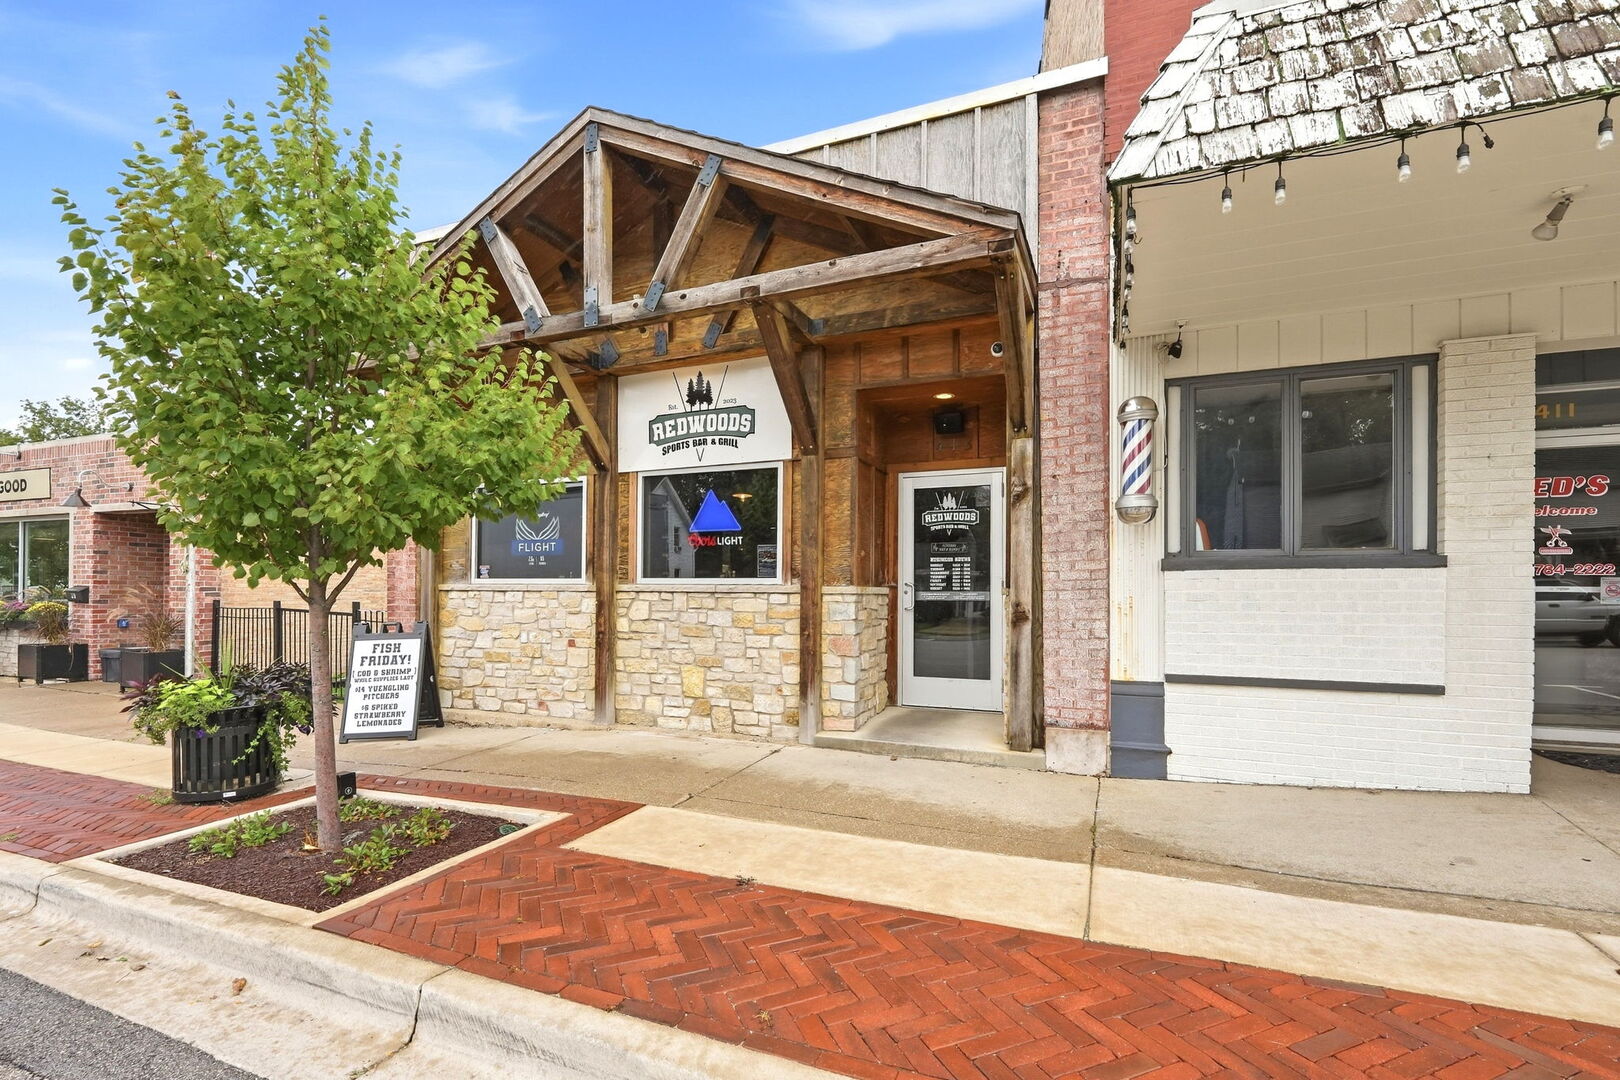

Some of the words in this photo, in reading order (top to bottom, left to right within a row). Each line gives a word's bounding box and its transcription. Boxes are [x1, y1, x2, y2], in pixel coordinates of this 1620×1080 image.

[1535, 402, 1576, 419] 411
[652, 413, 752, 442] REDWOODS
[662, 440, 690, 456] SPORTS
[692, 437, 708, 448] BAR
[710, 438, 717, 446] &
[718, 438, 739, 449] GRILL
[1533, 474, 1610, 498] ED'S
[1535, 505, 1598, 517] elcome
[925, 512, 976, 523] REDWOODS
[717, 536, 743, 546] LIGHT
[518, 542, 557, 552] FLIGHT
[372, 643, 401, 653] FISH
[360, 654, 411, 666] FRIDAY!
[381, 668, 411, 676] SHRIMP
[368, 684, 409, 692] YUENGLING
[363, 692, 399, 700] PITCHERS
[354, 711, 406, 719] STRAWBERRY
[357, 719, 402, 727] LEMONADES
